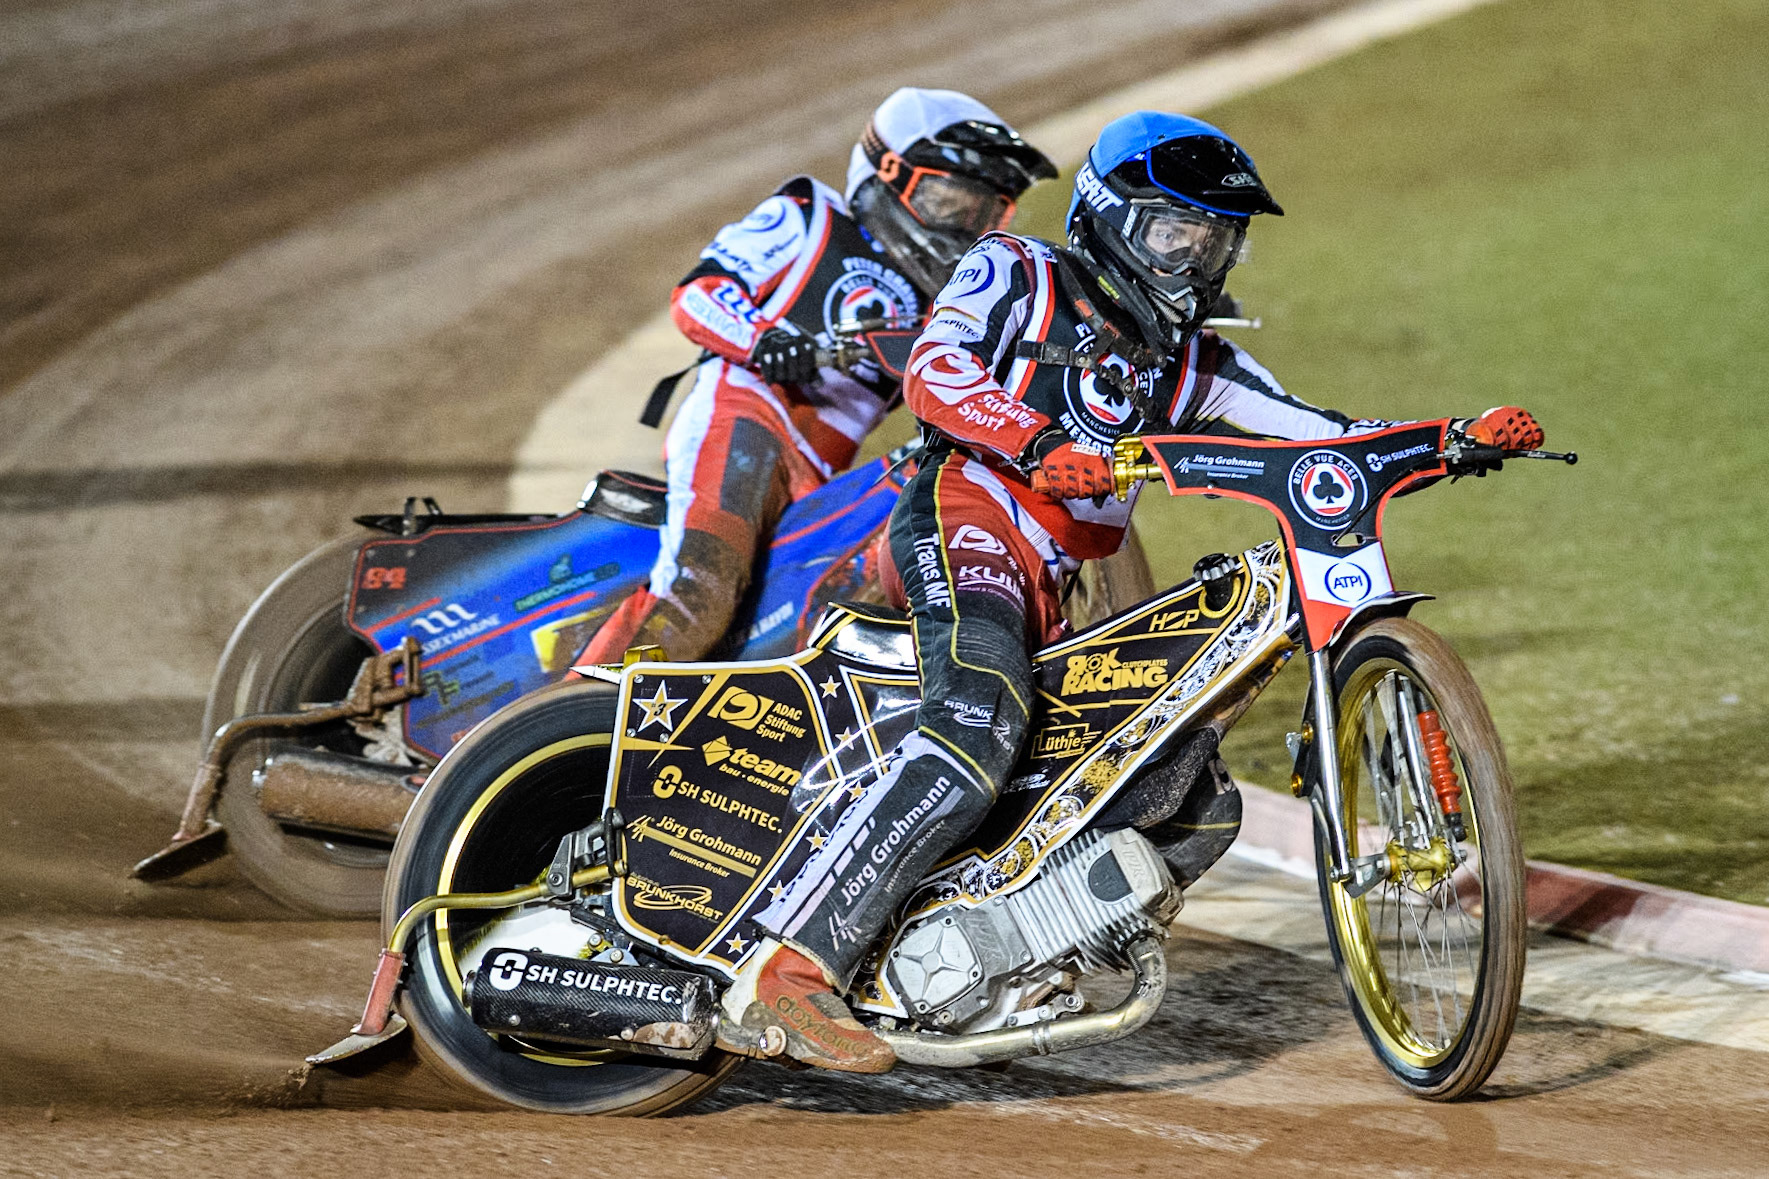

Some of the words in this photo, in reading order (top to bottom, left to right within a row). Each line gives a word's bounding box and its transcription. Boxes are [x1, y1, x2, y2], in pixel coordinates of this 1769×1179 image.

[1076, 162, 1125, 213] LEATT
[957, 402, 1006, 431] Sport
[1192, 454, 1215, 466] Jörg
[1215, 456, 1265, 469] Grohmann
[1292, 458, 1314, 485] BELLE
[1314, 454, 1334, 463] VUE
[1336, 460, 1359, 481] ACES
[1379, 455, 1392, 465] SH
[913, 533, 941, 582] Trans
[924, 581, 952, 608] MF
[1333, 575, 1363, 590] ATPI
[1061, 666, 1169, 697] RACING
[764, 715, 807, 739] Stiftung
[772, 702, 803, 721] ADAC
[756, 725, 786, 742] Sport
[719, 763, 742, 778] bau
[746, 774, 790, 797] energie
[728, 747, 802, 787] team
[677, 781, 701, 799] SH
[700, 789, 784, 834] SULPHTEC.
[656, 815, 690, 839] Jörg
[689, 828, 762, 866] Grohmann
[841, 862, 878, 906] Jörg
[870, 776, 951, 864] Grohmann
[884, 846, 918, 893] Insurance
[916, 819, 946, 847] Broker
[669, 849, 705, 870] Insurance
[704, 863, 731, 879] Broker
[626, 876, 723, 920] BRUNKHORST
[526, 964, 558, 984] SH
[560, 969, 683, 1005] SULPHTEC.
